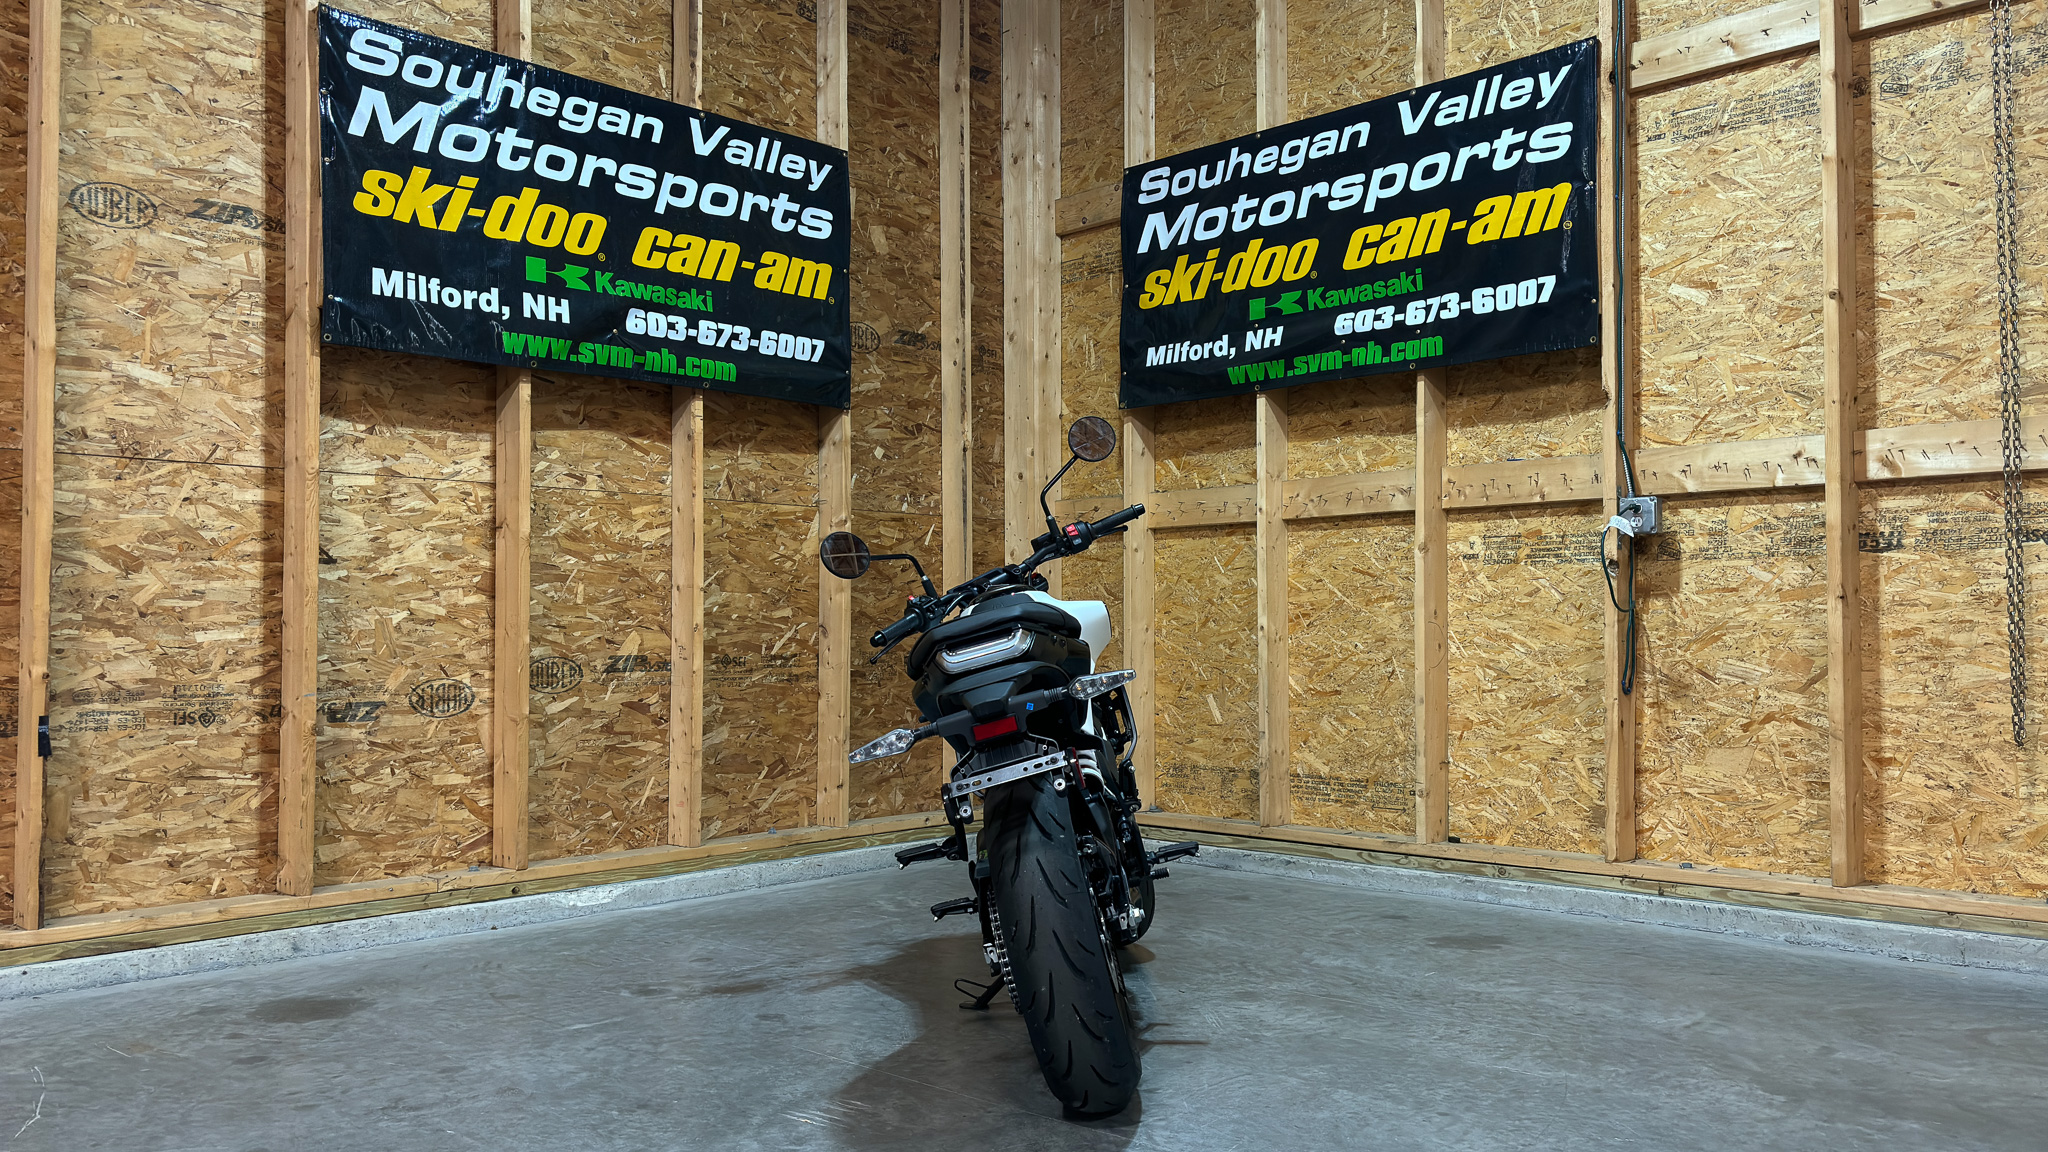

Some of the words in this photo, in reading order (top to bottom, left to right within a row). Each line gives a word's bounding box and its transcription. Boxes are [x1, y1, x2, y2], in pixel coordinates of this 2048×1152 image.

[346, 28, 663, 144] Souhegan
[690, 116, 832, 192] Valley
[1137, 121, 1371, 205] Souhegan
[1397, 64, 1573, 136] Valley
[347, 87, 834, 240] Motorsports
[1136, 121, 1574, 254] Motorsports
[353, 166, 608, 256] ski-doo
[631, 226, 833, 301] can-am
[1139, 238, 1320, 310] ski-doo
[1342, 182, 1573, 271] can-am
[371, 266, 510, 321] Milford,
[522, 291, 571, 324] NH
[595, 270, 714, 313] Kawasaki
[1306, 268, 1424, 311] Kawasaki
[1333, 275, 1557, 336] 603-673-6007
[502, 331, 737, 383] www.svm-nh.com
[626, 307, 825, 363] 603-673-6007
[1145, 334, 1236, 367] Milford,
[1245, 325, 1284, 353] NH
[1227, 335, 1444, 385] www.svm-nh.com
